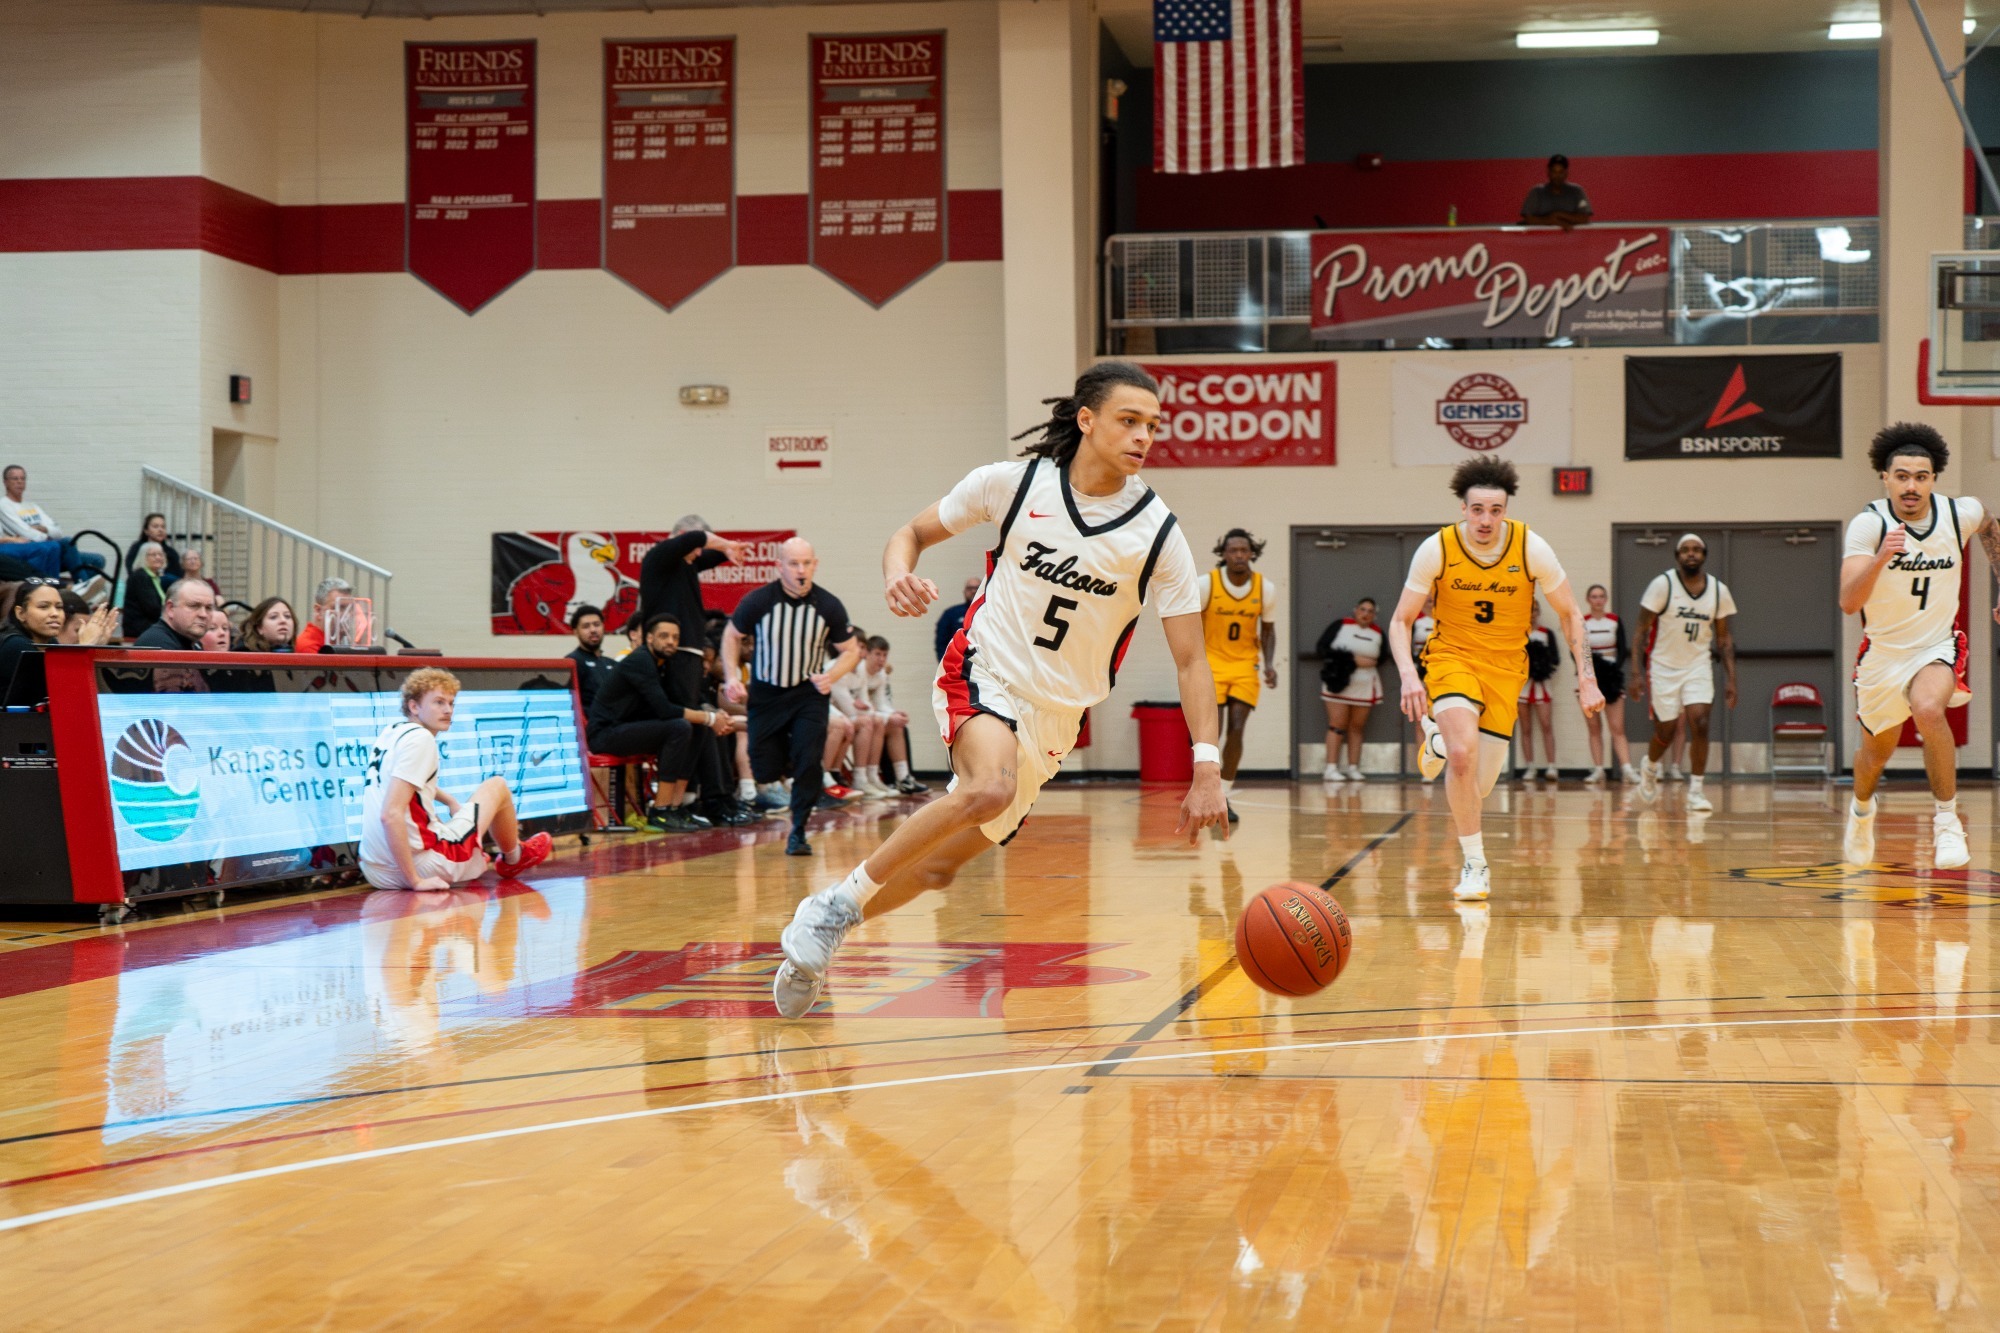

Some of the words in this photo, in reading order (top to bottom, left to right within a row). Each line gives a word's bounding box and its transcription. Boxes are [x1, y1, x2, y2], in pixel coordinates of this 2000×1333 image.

[419, 48, 523, 71] FRIENDS
[616, 45, 722, 69] FRIENDS
[823, 41, 931, 63] FRIENDS
[417, 70, 522, 84] UNIVERSITY
[615, 67, 720, 81] UNIVERSITY
[822, 62, 931, 76] UNIVERSITY
[1314, 243, 1488, 317] Promo
[1475, 233, 1657, 338] Depot
[1636, 256, 1667, 272] inc.
[1570, 320, 1664, 331] promodepot.com
[1157, 372, 1322, 405] McCOWN
[1450, 374, 1516, 400] HEALTH
[1443, 404, 1522, 420] GENESIS
[1153, 409, 1322, 442] GORDON
[1450, 424, 1514, 448] CLUBS
[769, 436, 828, 452] RESTROOMS
[1158, 446, 1322, 458] ONSTRUCTION
[1559, 470, 1587, 492] EXIT
[1020, 541, 1117, 596] Falcons
[1888, 551, 1955, 571] Falcons
[1451, 579, 1482, 591] Saint
[1484, 584, 1517, 596] Mary
[1911, 577, 1930, 610] 4
[1033, 595, 1079, 651] 5
[1474, 600, 1494, 624] 3
[1228, 622, 1241, 641] 0
[209, 746, 305, 775] Kansas
[261, 776, 354, 804] Center,
[1281, 896, 1334, 968] SPALDING
